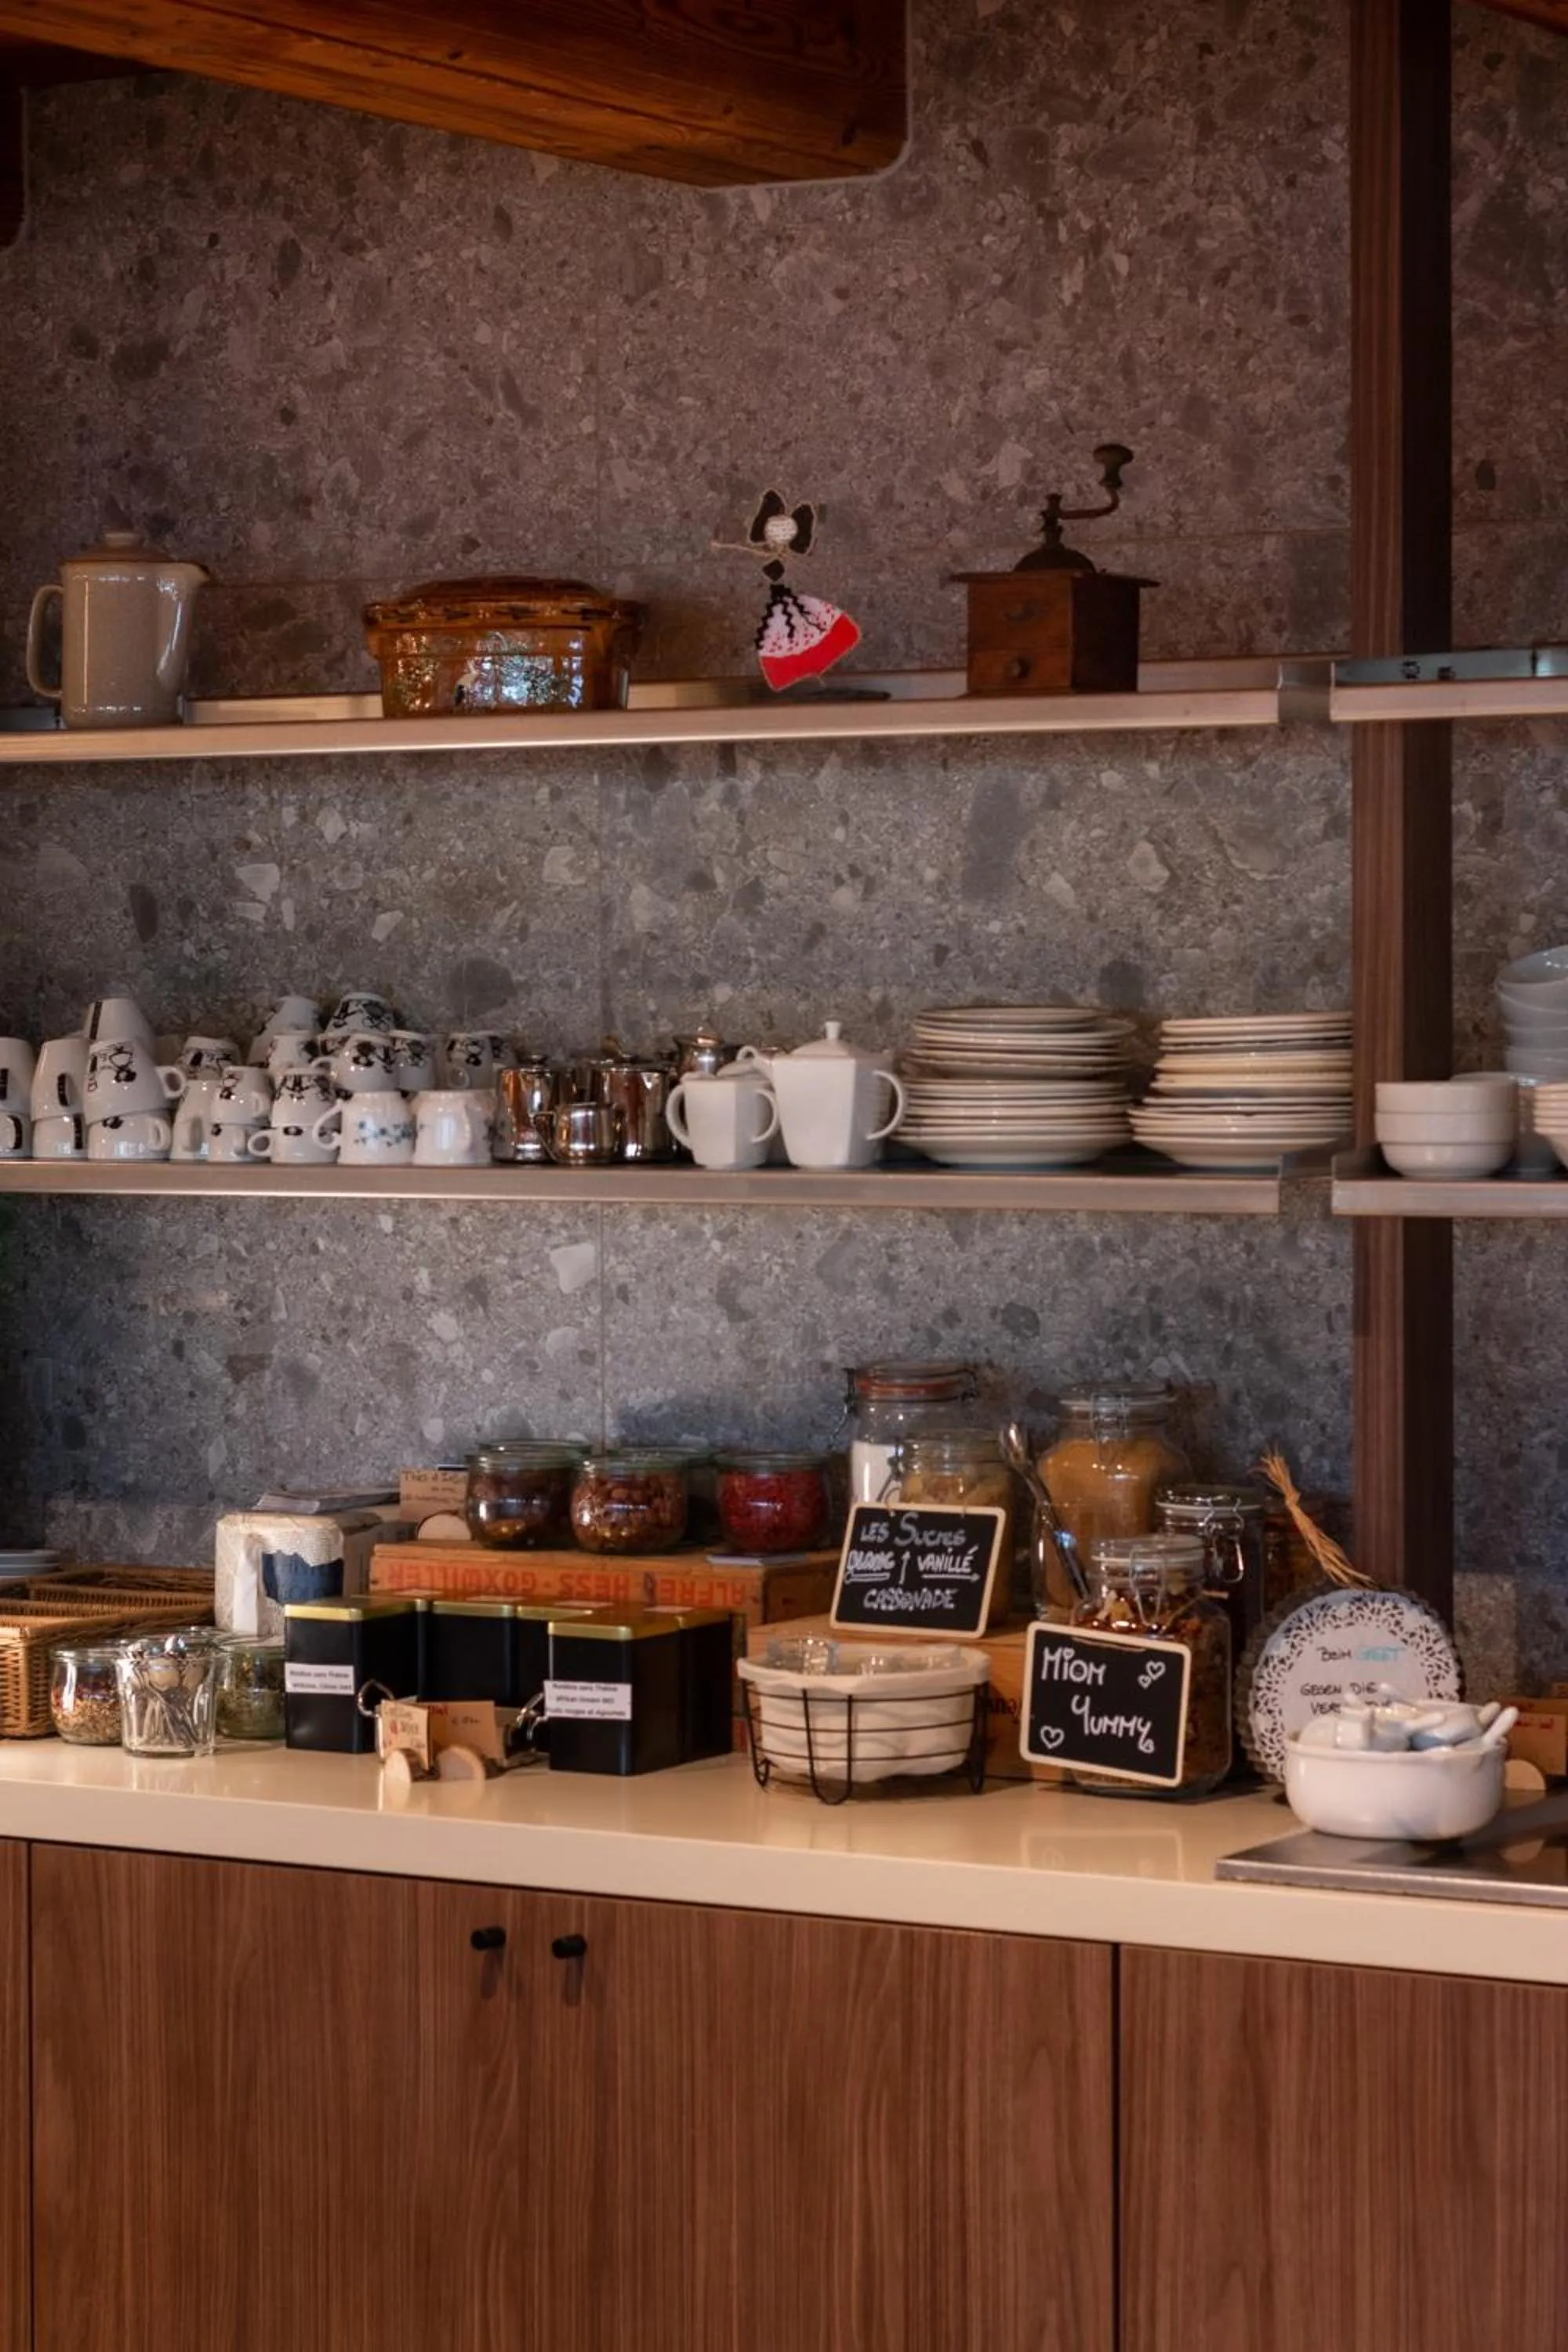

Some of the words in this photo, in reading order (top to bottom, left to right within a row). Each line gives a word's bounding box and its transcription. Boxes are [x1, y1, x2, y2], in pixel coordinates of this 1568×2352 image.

[861, 1523, 889, 1542] LES
[558, 1571, 631, 1599] HESS
[643, 1571, 744, 1606] ALFRE
